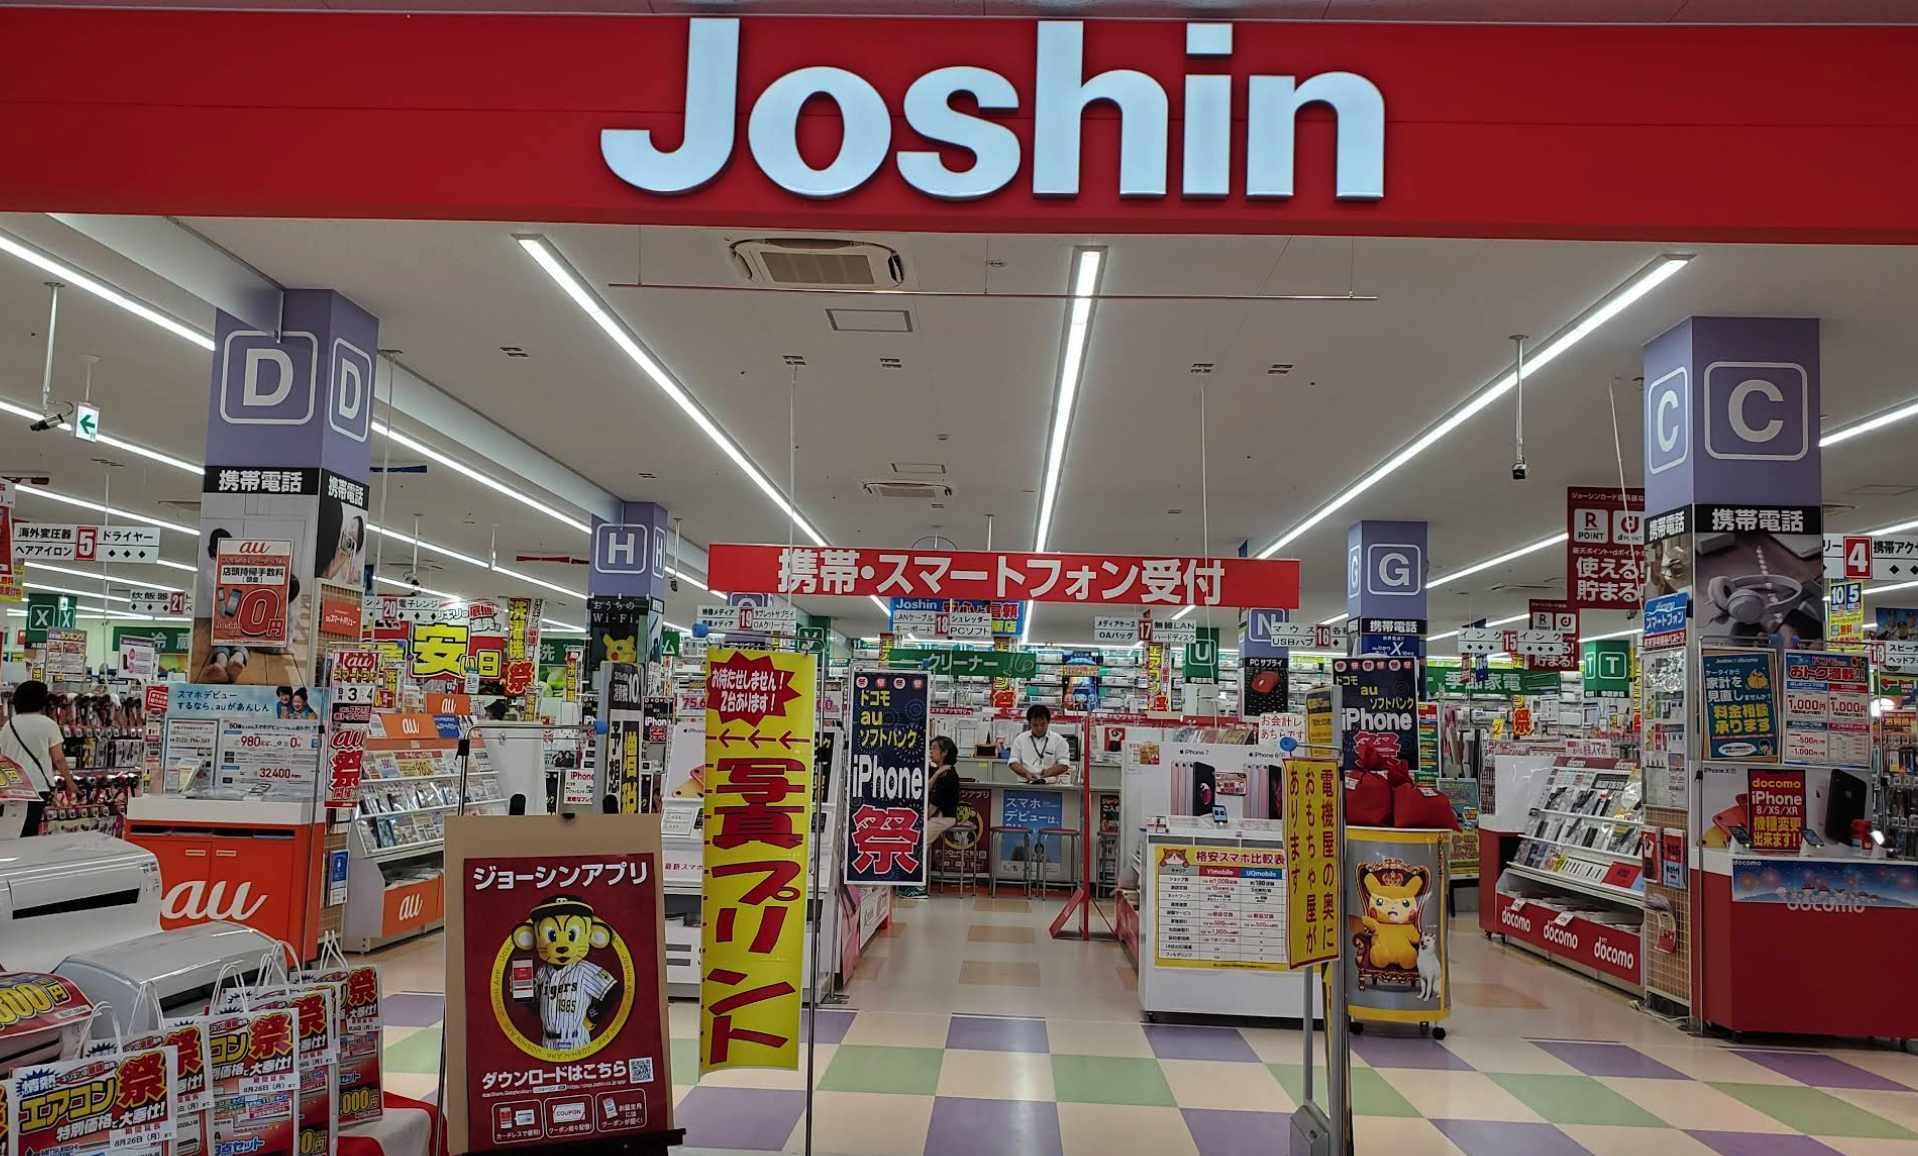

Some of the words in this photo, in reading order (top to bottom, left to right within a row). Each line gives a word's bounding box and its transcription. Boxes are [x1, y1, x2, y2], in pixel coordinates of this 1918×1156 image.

[600, 17, 1385, 198] Joshin
[243, 348, 295, 407] D
[338, 357, 362, 420] D
[1728, 379, 1784, 443] C
[1657, 390, 1679, 453] C
[218, 470, 303, 493] 携帯電話
[328, 475, 364, 508] 携帯電話
[1584, 511, 1598, 531] R
[1650, 510, 1685, 542] 携帯電話
[1712, 508, 1804, 533] 携帯電話
[18, 527, 72, 540] 海外変圧器
[78, 531, 93, 557] 5
[102, 532, 154, 542] ドライヤー
[1578, 531, 1605, 540] POINT
[15, 545, 73, 557] ヘアアイロン
[239, 541, 271, 554] au
[607, 532, 636, 565] H
[655, 536, 664, 570] H
[1351, 555, 1359, 577] G
[1847, 542, 1868, 573] 4
[777, 549, 1226, 606] 携帯・スマートフォン受付
[1378, 552, 1411, 587] G
[1576, 556, 1645, 580] 使える!
[1576, 580, 1645, 603] 貯まる!
[1831, 586, 1845, 605] 10
[1848, 584, 1860, 603] 5
[171, 594, 183, 612] 21
[383, 601, 396, 618] 20
[400, 599, 439, 609] 電子レンジ
[593, 601, 635, 611] おうちの
[896, 598, 937, 610] Joshin
[35, 609, 50, 626] X
[62, 611, 72, 628] X
[702, 608, 735, 617] 映像メディア
[740, 609, 753, 628] 19
[936, 615, 949, 634] 18
[951, 615, 990, 623] シュレッダー
[1258, 613, 1276, 636] N
[1369, 620, 1418, 633] 携帯電話
[1539, 614, 1548, 624] R
[1646, 610, 1684, 630] スマートフォン
[896, 625, 933, 633] キーボード
[950, 626, 990, 636] PCソフト
[1099, 631, 1134, 640] OAバッグ
[1154, 634, 1195, 642] ハードディスク
[1139, 622, 1152, 639] 17
[1154, 621, 1195, 630] 無線LAN
[1272, 625, 1315, 634] マウス
[1316, 628, 1329, 645] 16
[1272, 638, 1315, 646] USBハブ
[1460, 631, 1502, 641] インク
[1503, 632, 1517, 650] 15
[1520, 632, 1563, 642] インク
[1195, 643, 1209, 661] U
[346, 655, 374, 669] au
[927, 652, 999, 672] クリーナー
[1534, 656, 1575, 668] 貯まる!
[1586, 656, 1594, 676] T
[1605, 657, 1620, 674] T
[711, 667, 784, 692] お待たせしません！
[1335, 675, 1359, 686] ドコモ
[1705, 668, 1741, 676] ケータイから
[1361, 685, 1378, 696] au
[1706, 676, 1743, 690] 家計を
[177, 689, 238, 700] スマホデビュー
[720, 691, 776, 714] 2台あります！
[860, 690, 891, 707] ドコモ
[1370, 697, 1414, 710] ソフトバンク
[177, 701, 270, 713] するなら、auがあんしん
[441, 698, 457, 714] au
[1713, 703, 1769, 719] 料金相談
[1788, 699, 1826, 711] 1,000円
[1831, 701, 1868, 713] 1,000円
[402, 718, 420, 735] au
[861, 709, 883, 726] au
[1341, 707, 1413, 731] iPhone
[1715, 718, 1771, 734] 承ります
[240, 735, 261, 747] 980
[331, 729, 366, 749] au
[860, 728, 918, 749] ソフトバンク
[330, 750, 364, 791] 祭
[853, 754, 923, 800] iPhone
[1752, 778, 1801, 789] docomo
[1006, 797, 1041, 809] スマホ
[1751, 791, 1803, 807] iPhone
[1756, 806, 1799, 816] 8/XS/XR
[1288, 766, 1301, 895] あります
[1753, 816, 1802, 832] 機種変更
[851, 804, 921, 875] 祭
[1195, 850, 1286, 866] 格安スマホ比較表
[1304, 766, 1318, 955] おもちゃ屋が
[1320, 768, 1335, 952] 電機屋の奥に
[1732, 859, 1762, 867] docomo
[473, 860, 648, 891] ジョーシンアプリ
[1206, 868, 1234, 876] Y!mobile
[160, 880, 269, 921] au
[399, 893, 423, 921] au
[707, 757, 806, 1066] 写真プリント
[1502, 909, 1532, 934] docomo
[1543, 921, 1579, 950] docomo
[1593, 936, 1635, 970] docomo
[346, 966, 379, 1006] 祭
[482, 1060, 628, 1090] ダウンロードはこちら
[556, 1108, 582, 1117] COUPON
